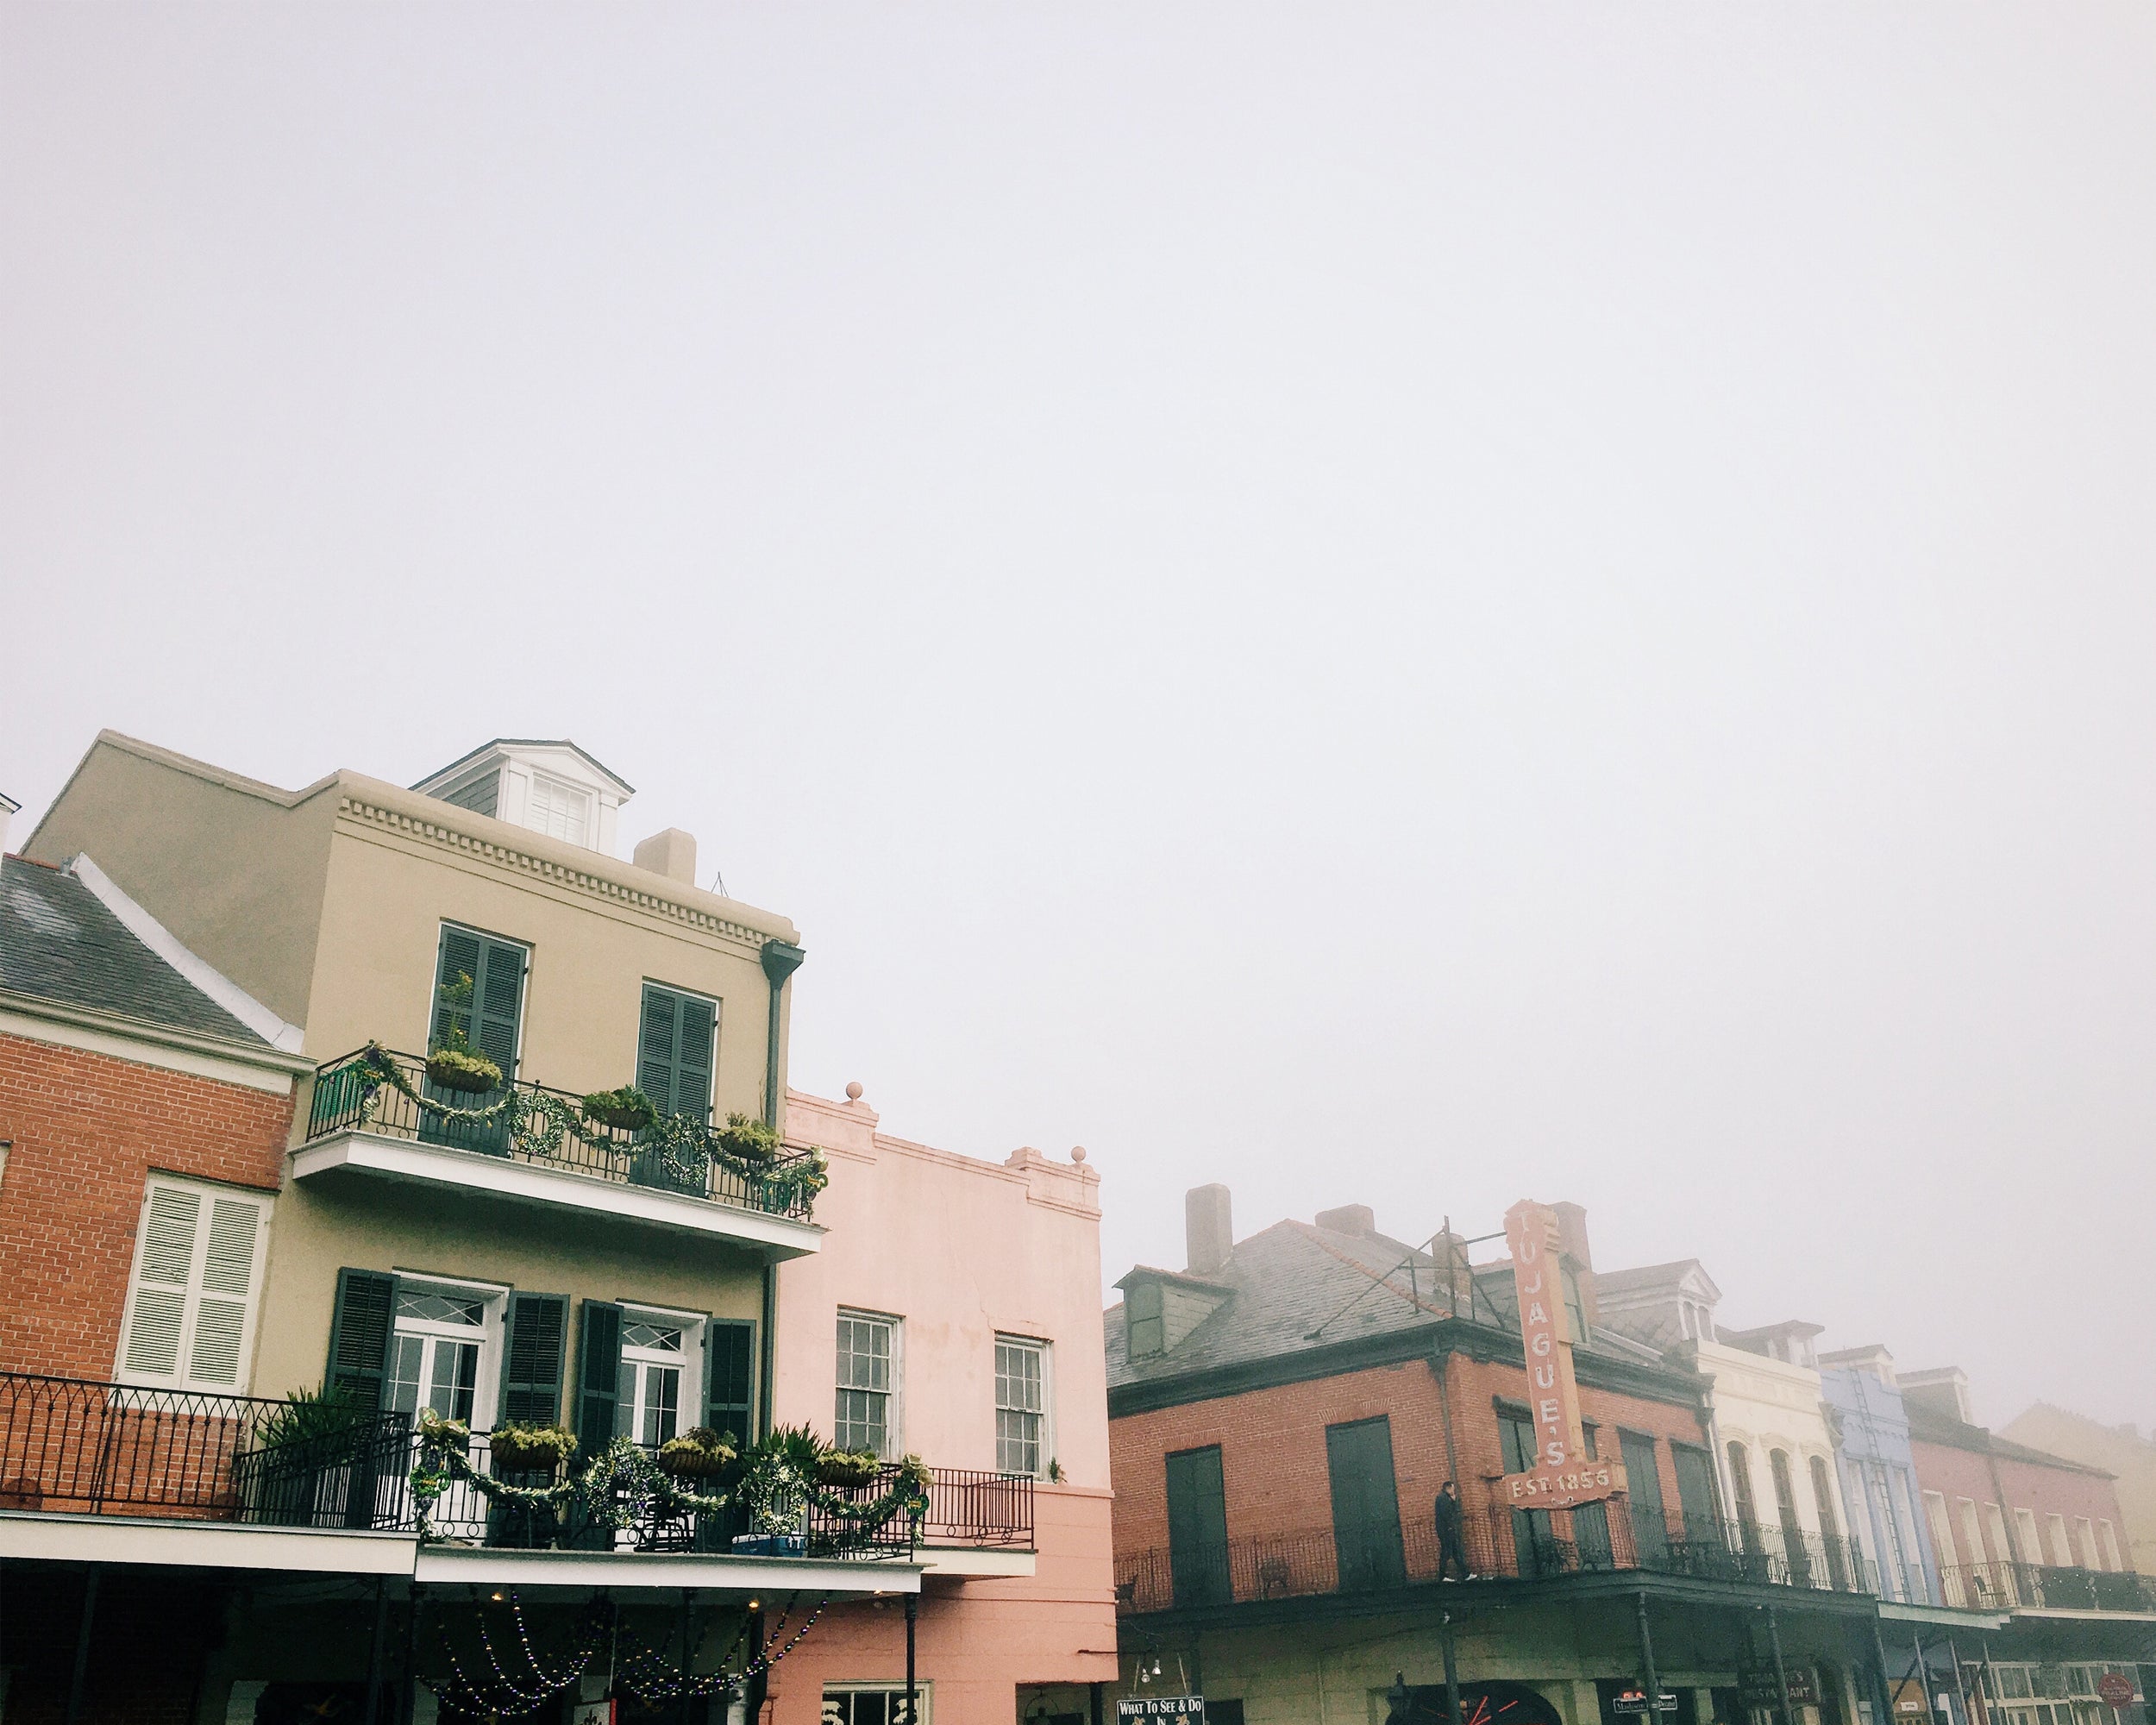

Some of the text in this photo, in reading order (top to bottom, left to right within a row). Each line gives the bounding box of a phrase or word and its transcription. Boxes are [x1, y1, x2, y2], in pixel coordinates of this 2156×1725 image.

[1519, 1211, 1565, 1466] TUJAGUE'S
[1557, 1470, 1611, 1493] 1856
[1178, 1700, 1186, 1712] &
